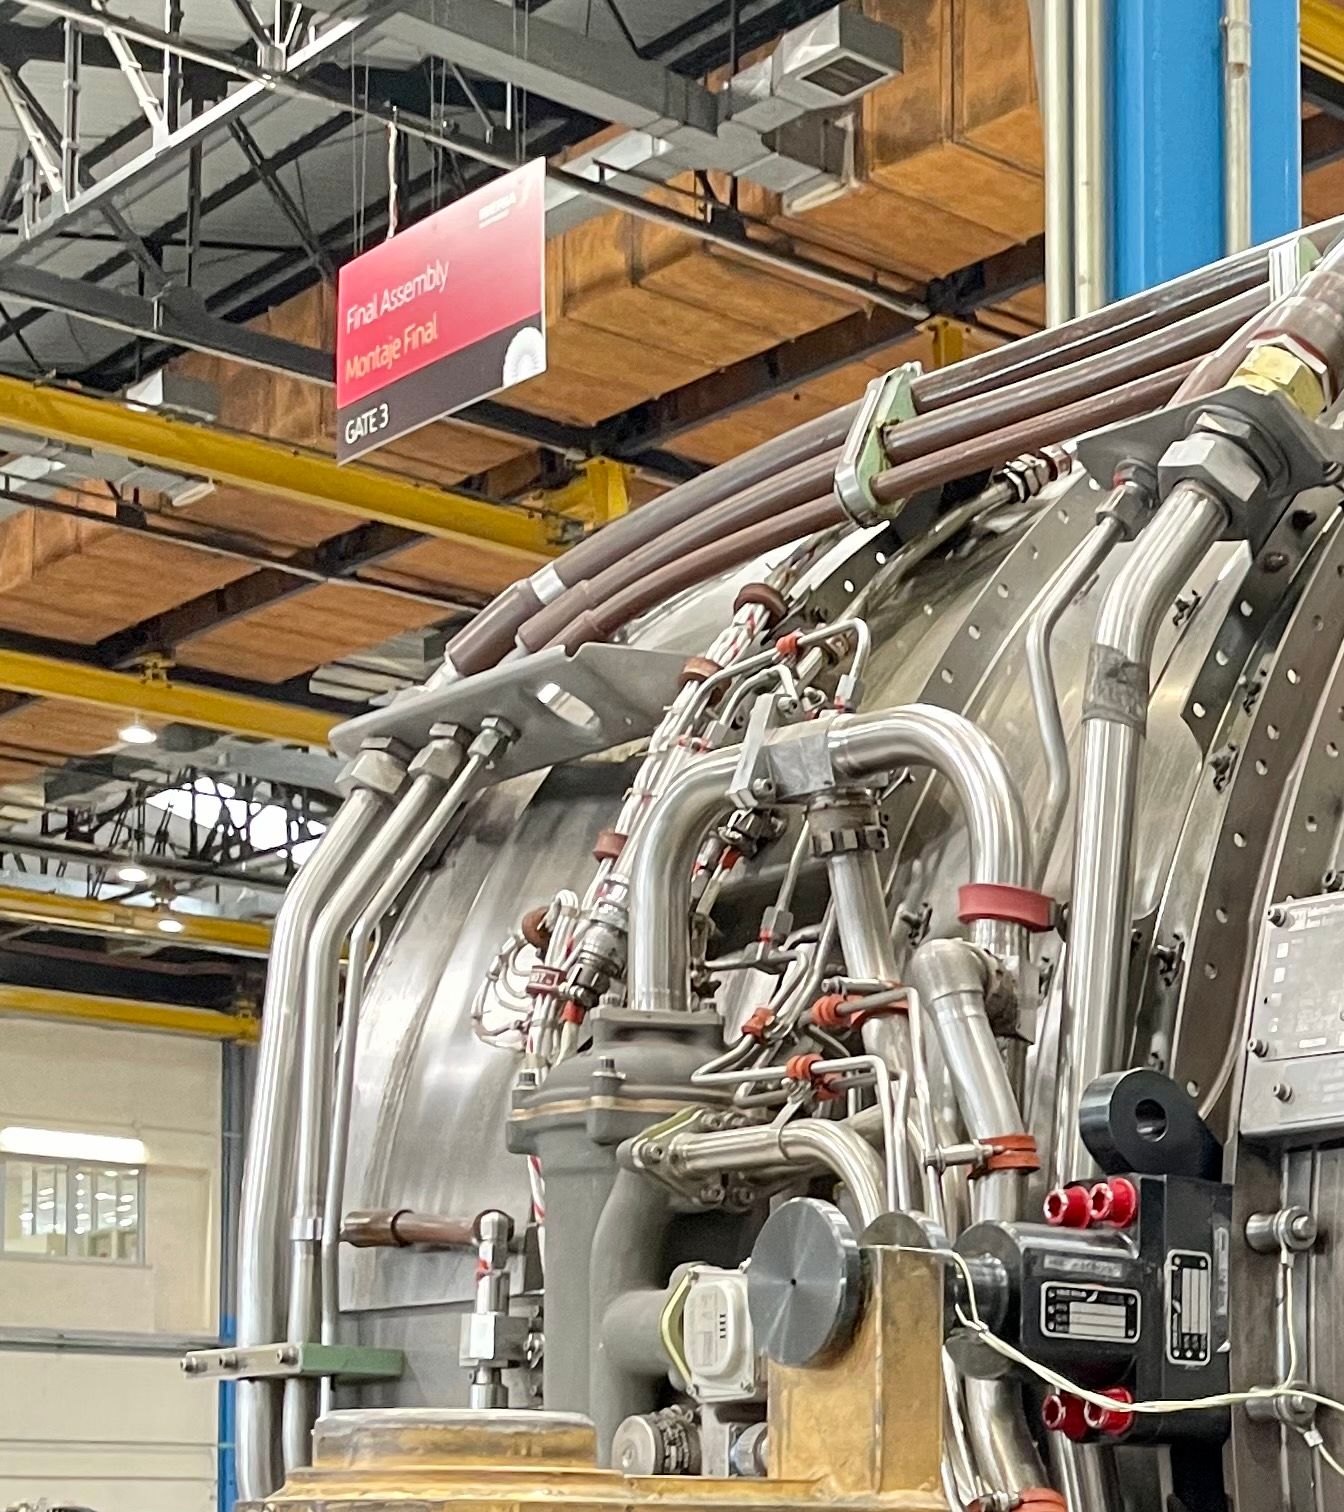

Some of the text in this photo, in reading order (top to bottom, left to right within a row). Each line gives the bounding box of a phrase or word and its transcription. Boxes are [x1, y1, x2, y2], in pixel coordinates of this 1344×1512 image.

[346, 259, 449, 335] Final Assembly
[345, 313, 437, 382] Montaje Final
[345, 403, 390, 444] GATE 3
